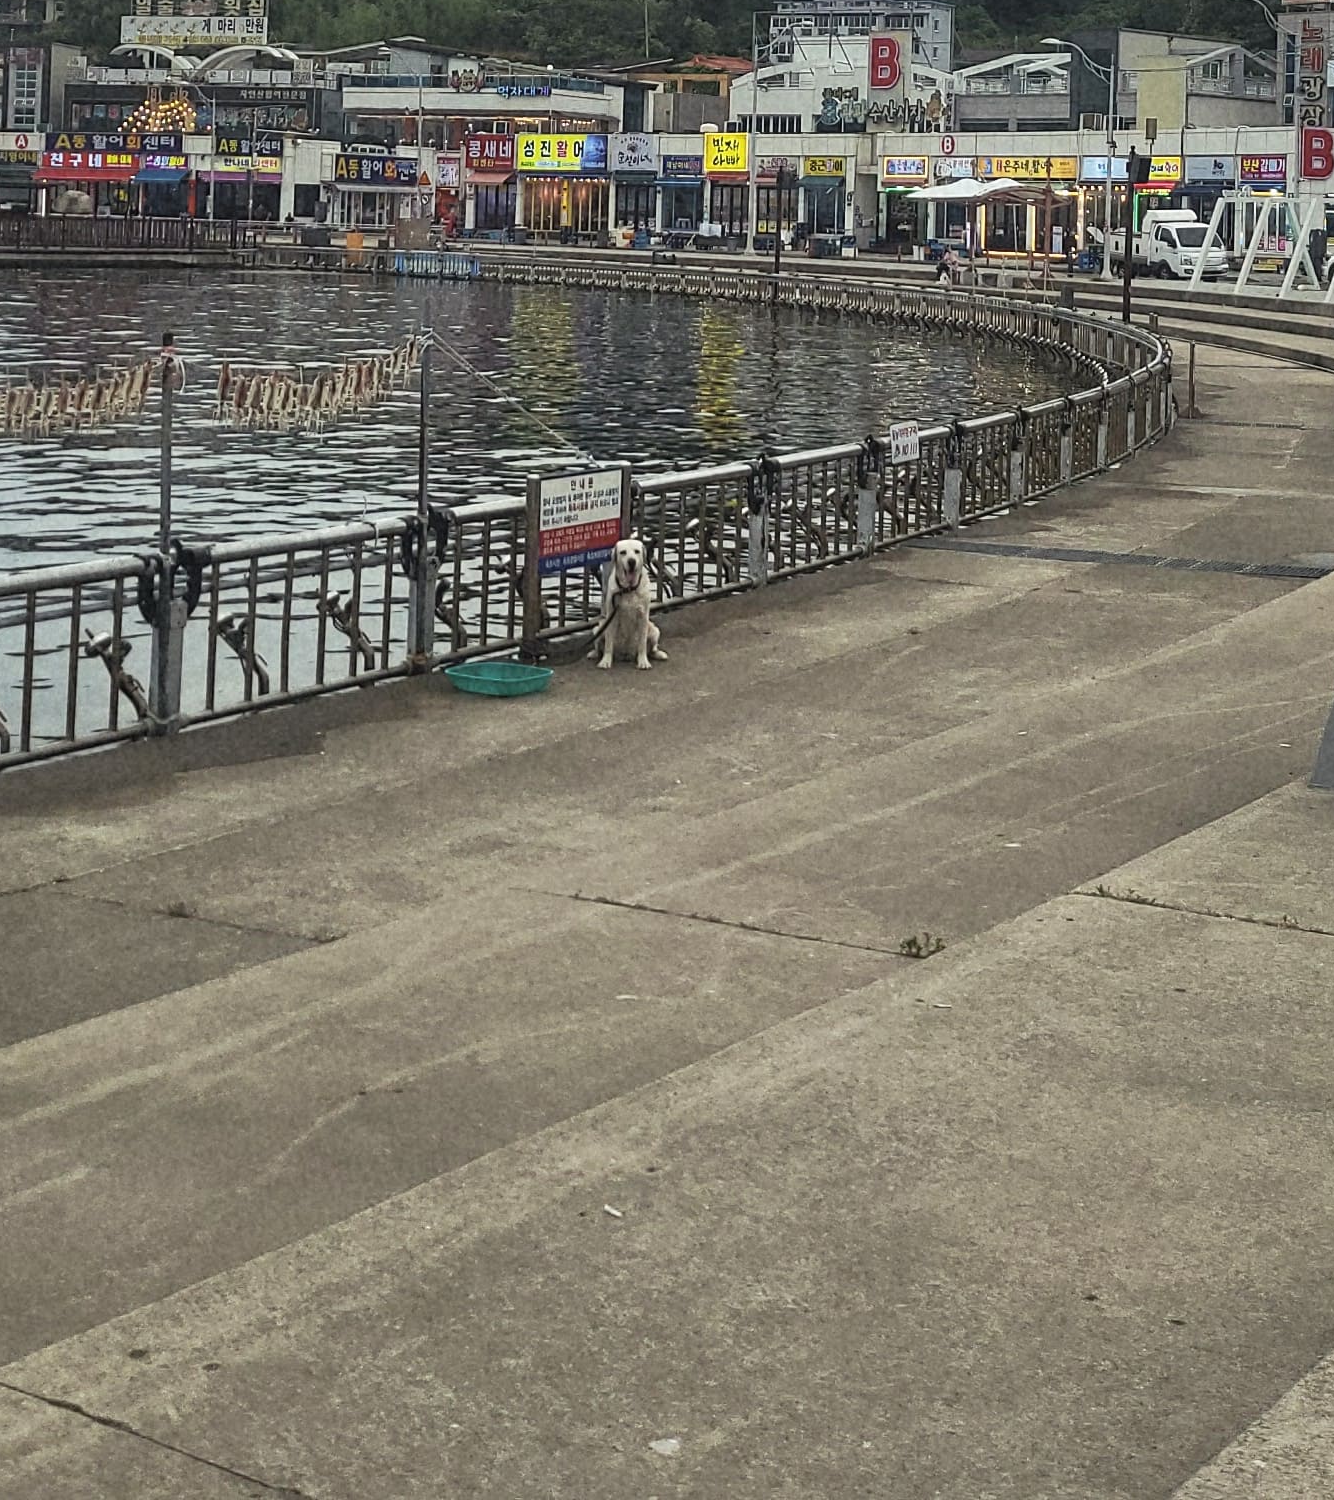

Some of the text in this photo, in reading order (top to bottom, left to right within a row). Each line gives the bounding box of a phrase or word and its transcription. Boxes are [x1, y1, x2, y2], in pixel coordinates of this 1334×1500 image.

[218, 18, 235, 33] 마리
[870, 37, 901, 89] B
[54, 135, 86, 148] A동
[524, 139, 584, 157] 성진활어
[713, 155, 740, 166] 아빠
[1302, 128, 1334, 180] B
[336, 156, 359, 179] A동
